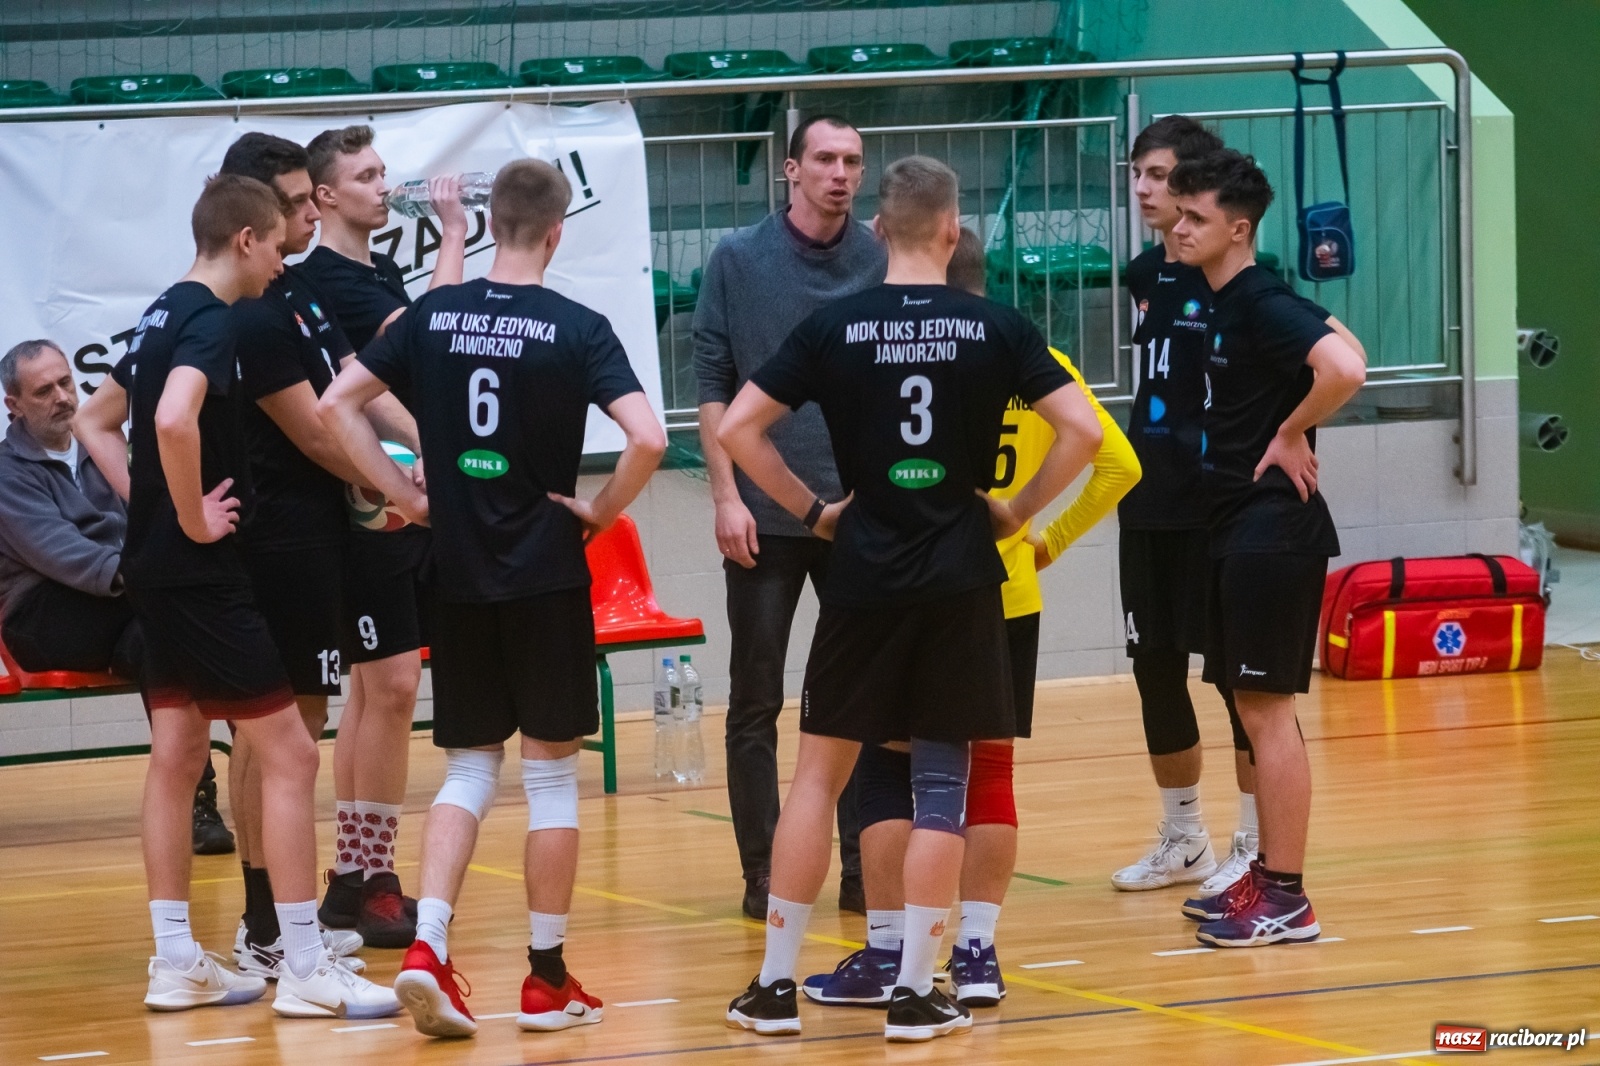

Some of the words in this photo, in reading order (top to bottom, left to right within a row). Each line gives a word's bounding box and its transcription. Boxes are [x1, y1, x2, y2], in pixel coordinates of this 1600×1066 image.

[429, 312, 461, 331] MDK
[461, 313, 490, 333] UKS
[491, 316, 556, 343] JEDYNKA
[846, 320, 879, 344] MDK
[883, 320, 914, 341] UKS
[918, 317, 986, 342] JEDYNKA
[449, 333, 523, 358] JAWORZNO
[874, 341, 957, 364] JAWORZNO
[1147, 338, 1171, 379] 14
[468, 367, 500, 437] 6
[900, 374, 933, 446] 3
[463, 458, 503, 471] MIKI
[895, 468, 939, 480] MIKI
[358, 615, 378, 651] 9
[317, 649, 341, 686] 13
